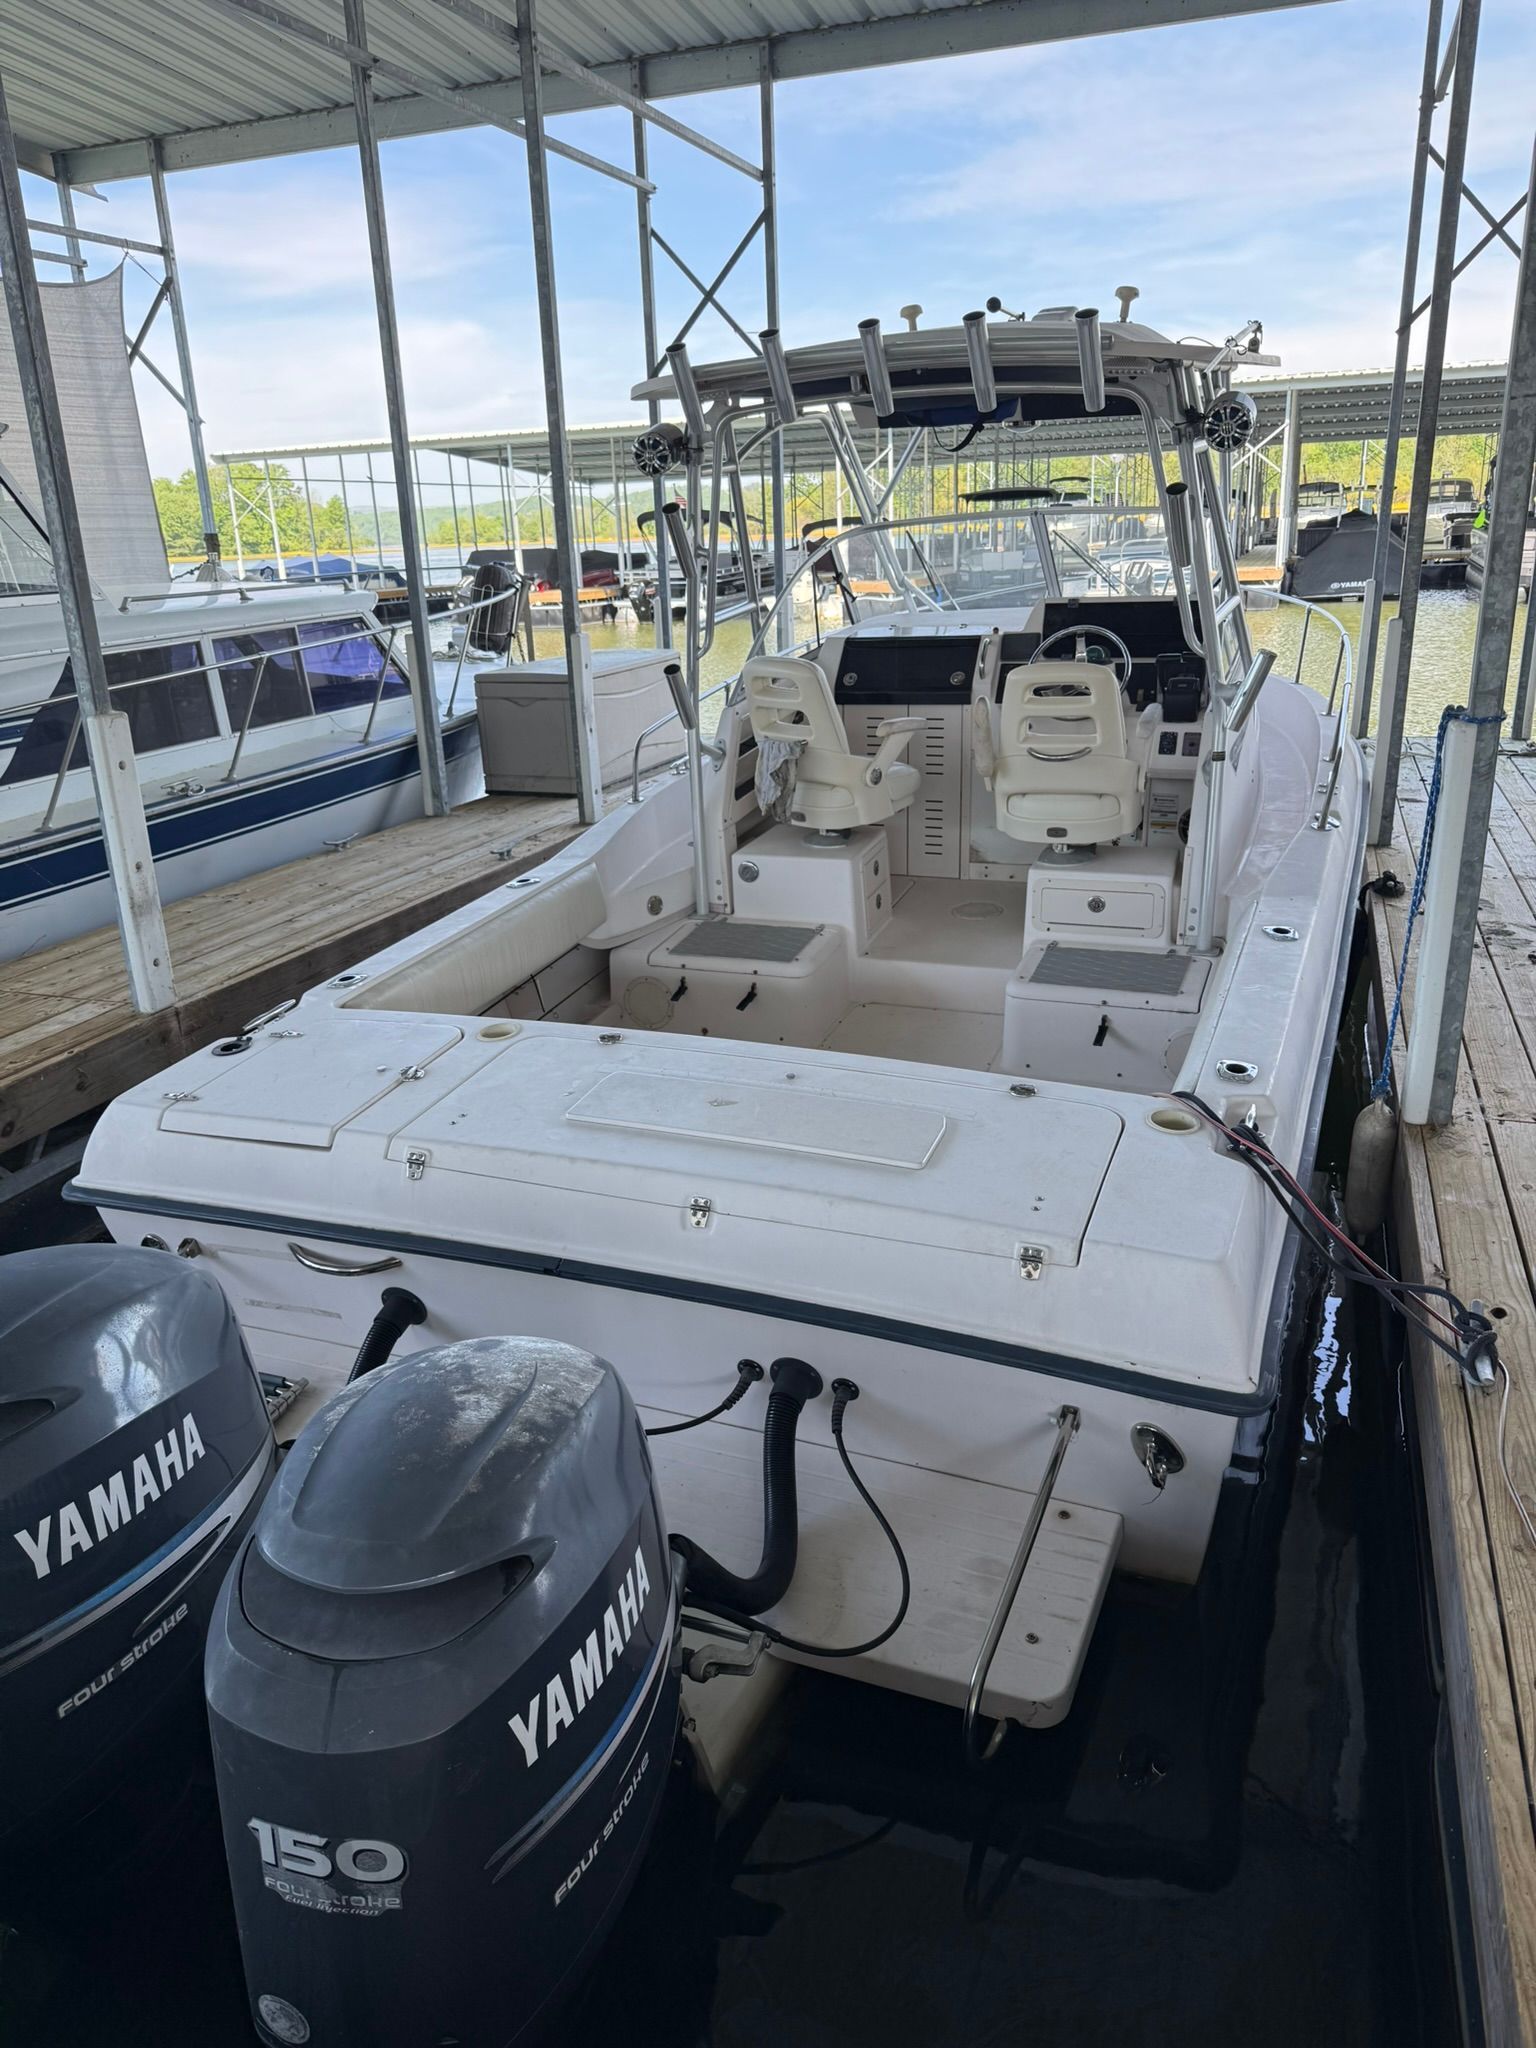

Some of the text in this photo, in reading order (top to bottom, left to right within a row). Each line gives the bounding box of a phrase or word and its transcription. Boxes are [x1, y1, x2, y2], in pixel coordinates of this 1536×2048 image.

[14, 1412, 206, 1580] YAMAHA
[507, 1545, 650, 1768] YAMAHA
[247, 1817, 406, 1884] 150
